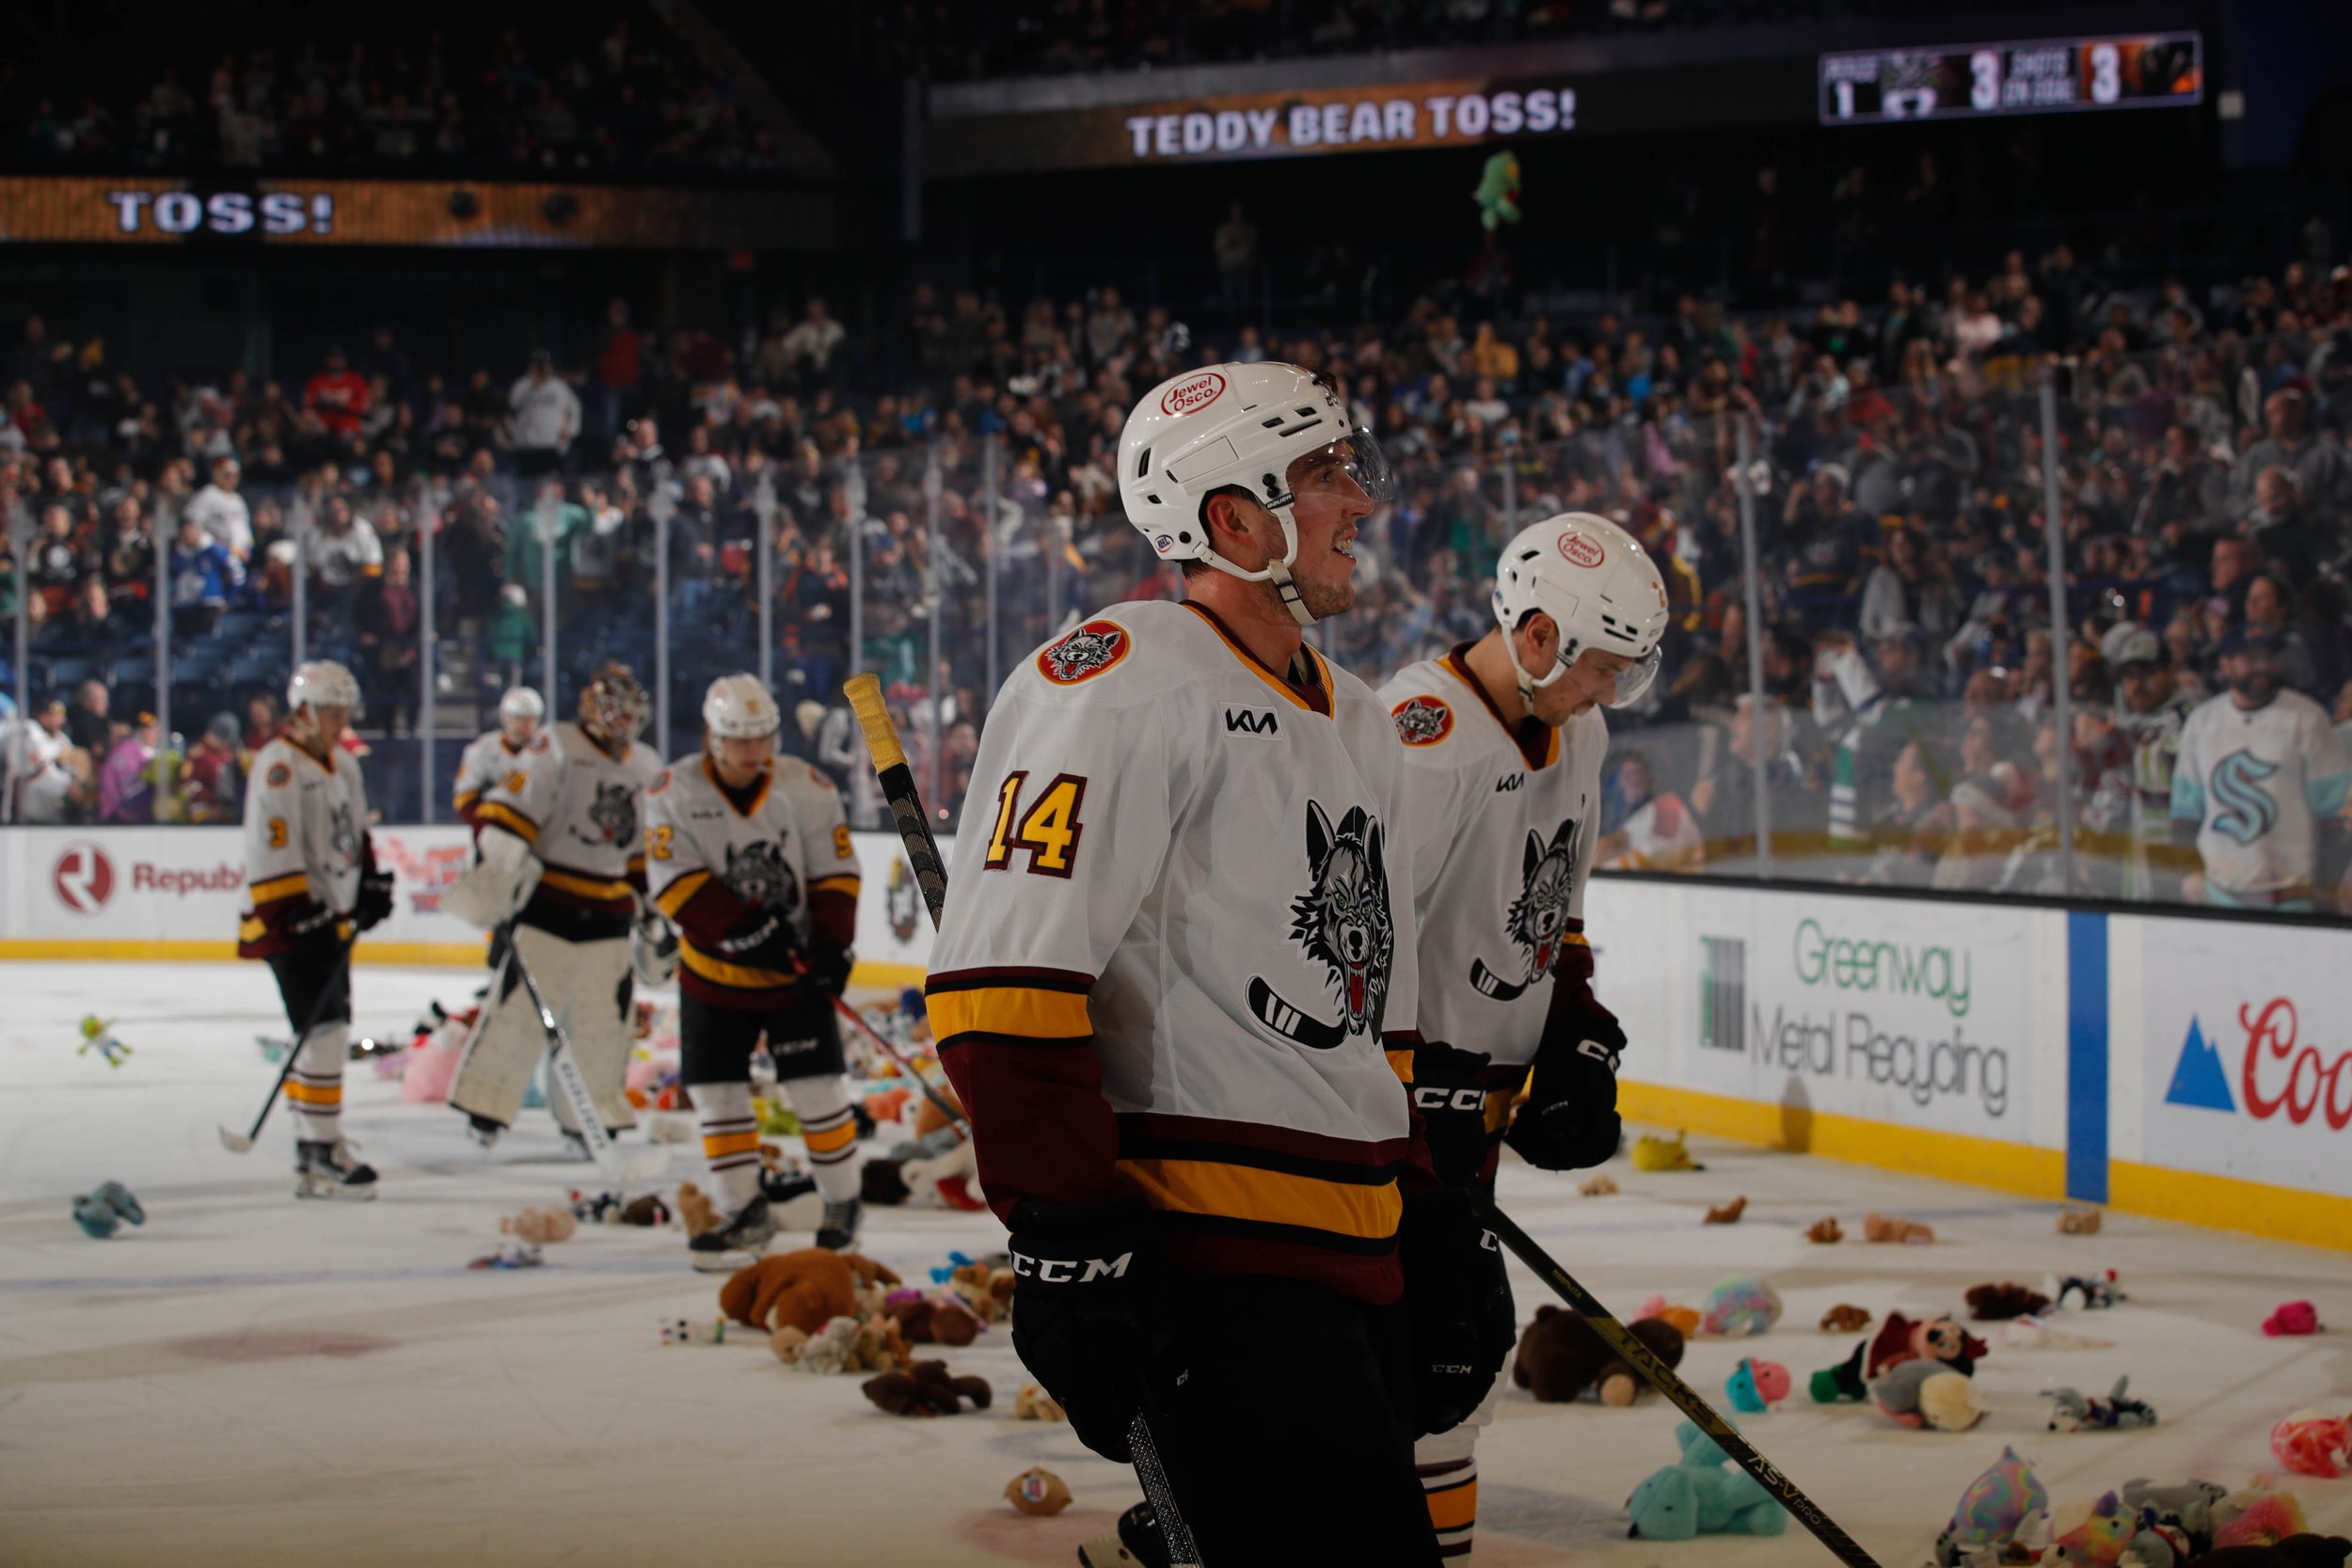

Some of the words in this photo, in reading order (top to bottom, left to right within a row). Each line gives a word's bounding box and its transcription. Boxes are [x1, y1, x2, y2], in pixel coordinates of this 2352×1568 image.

[1971, 49, 2000, 111] 3
[2091, 43, 2122, 104] 3
[1125, 107, 1279, 158] TEDDY
[1287, 99, 1416, 147] BEAR
[1425, 88, 1577, 137] TOSS!
[107, 191, 333, 234] TOSS!
[1168, 375, 1212, 404] Jewel
[1565, 535, 1600, 557] Jewel
[983, 769, 1088, 879] 14
[1794, 918, 1971, 1017] Greenway
[1751, 1003, 1836, 1076] Metal
[1846, 1012, 2007, 1118] Recycling
[1414, 1086, 1487, 1111] CC
[1012, 1250, 1134, 1283] CCM
[1430, 1364, 1473, 1374] CCM
[1793, 1497, 1821, 1526] PRO
